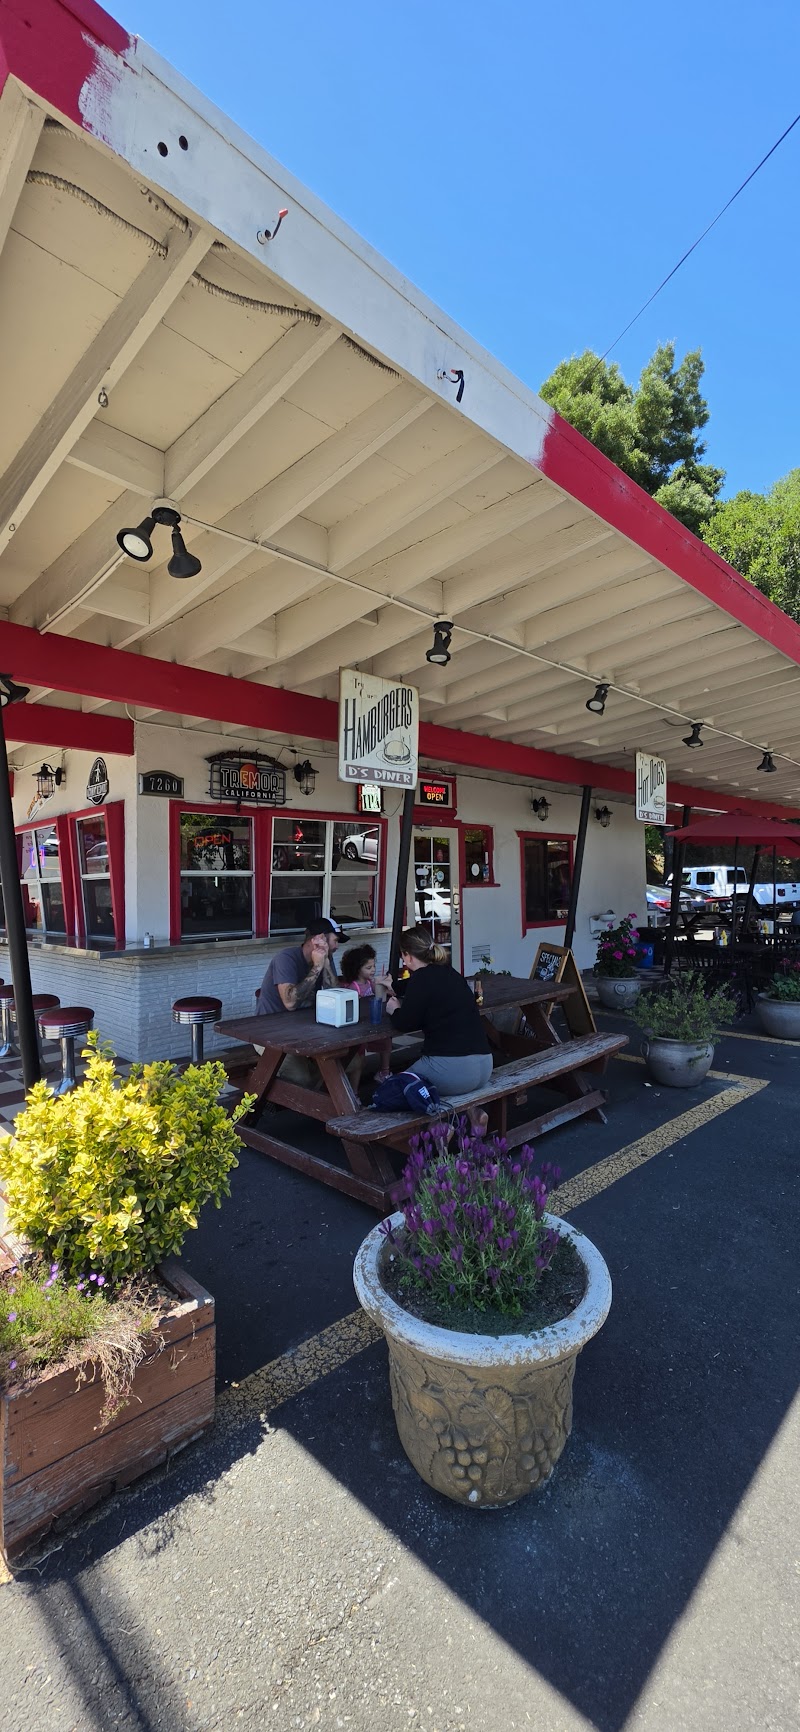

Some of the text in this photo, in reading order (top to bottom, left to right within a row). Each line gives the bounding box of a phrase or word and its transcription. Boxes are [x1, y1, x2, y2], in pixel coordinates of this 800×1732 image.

[344, 687, 413, 761] HAMBURGERS
[220, 768, 280, 792] TREMOR
[348, 766, 411, 784] D'S DINER
[650, 759, 665, 797] DOGS
[150, 777, 178, 791] 7260
[423, 785, 446, 794] WELCOME
[638, 768, 649, 807] HOT
[225, 789, 277, 799] CALIFORNIA
[363, 794, 381, 809] IPA
[427, 793, 444, 801] OPEN
[649, 813, 664, 822] DINER
[193, 833, 232, 848] OPEN
